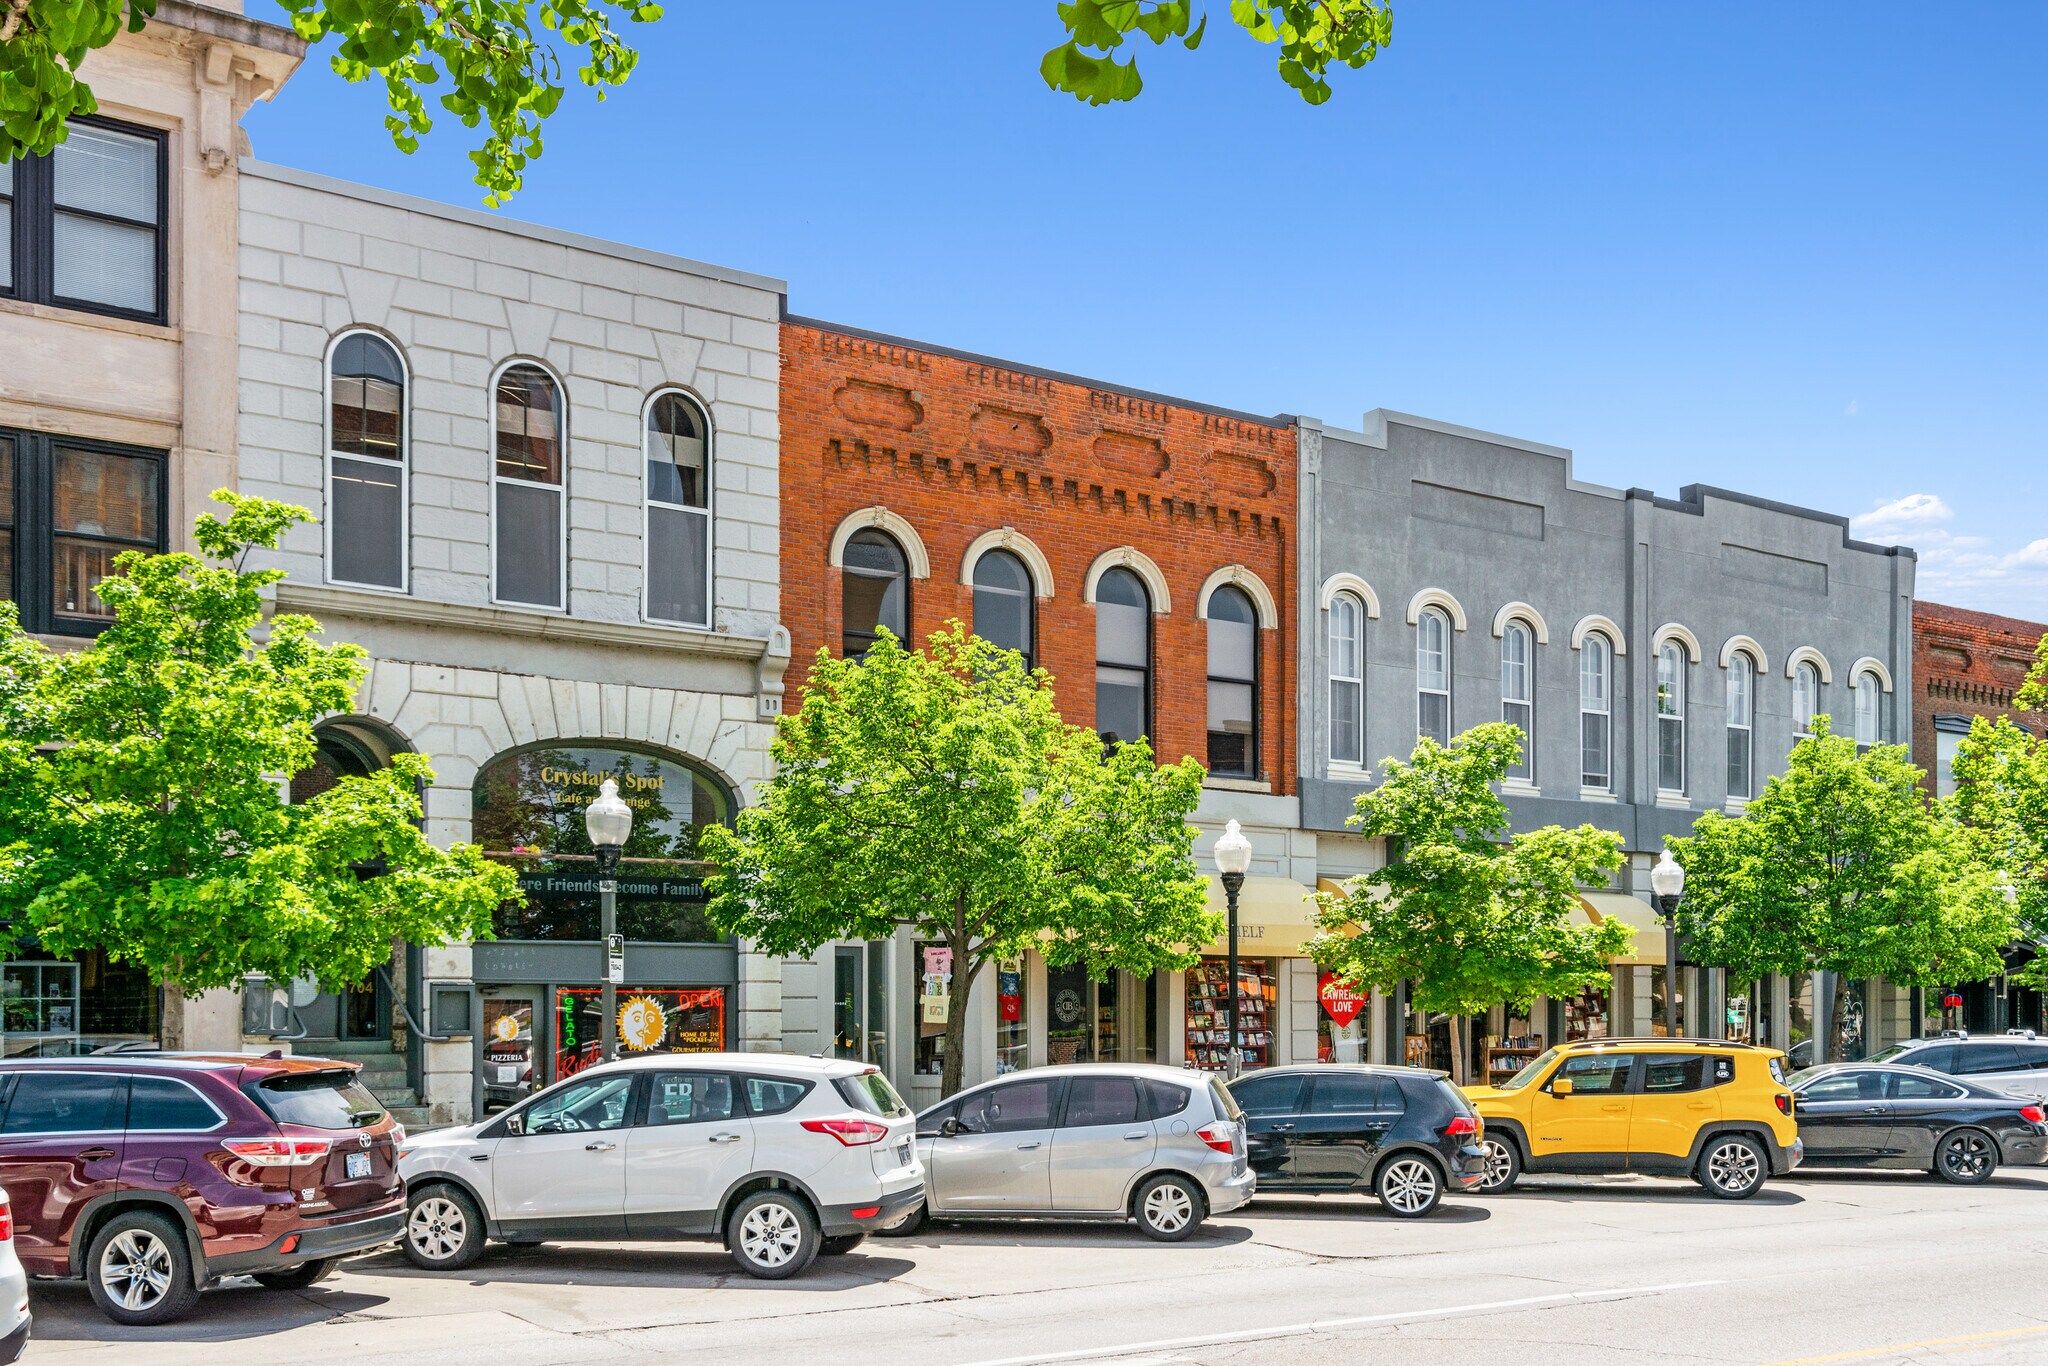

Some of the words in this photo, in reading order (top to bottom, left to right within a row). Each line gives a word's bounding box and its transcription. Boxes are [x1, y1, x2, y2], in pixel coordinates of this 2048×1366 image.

[541, 767, 619, 787] Crystal's
[625, 772, 665, 791] Spot
[519, 879, 542, 890] ere
[547, 878, 599, 892] Friends
[616, 883, 658, 894] ecome
[663, 882, 706, 898] Family
[679, 993, 720, 1010] OPEN
[1333, 1001, 1353, 1012] LOVE
[564, 997, 577, 1046] GELATO
[490, 1054, 524, 1062] PIZZERIA
